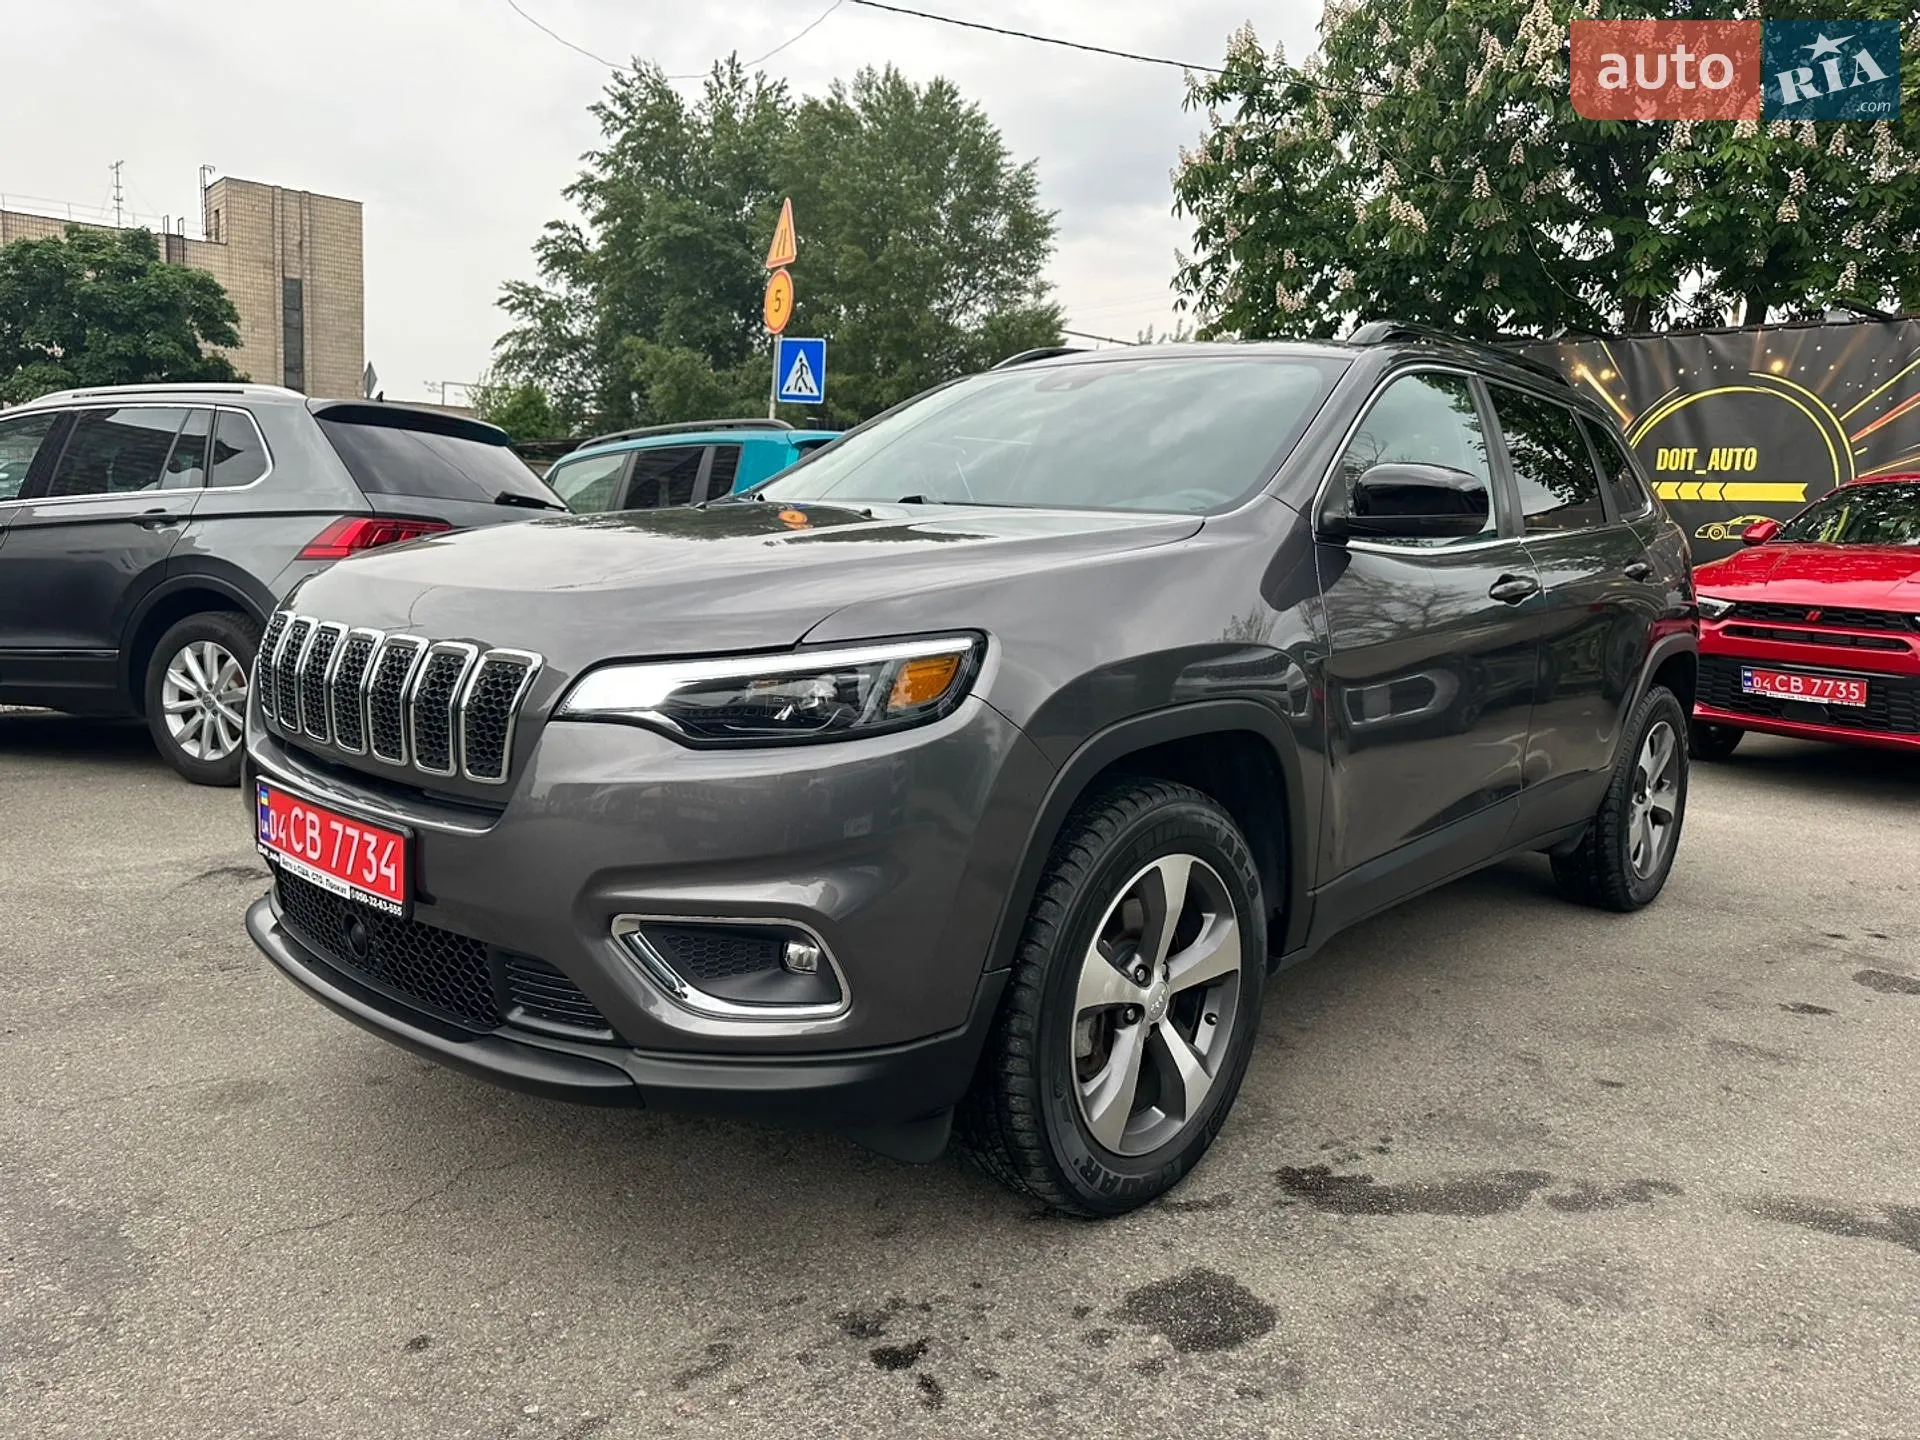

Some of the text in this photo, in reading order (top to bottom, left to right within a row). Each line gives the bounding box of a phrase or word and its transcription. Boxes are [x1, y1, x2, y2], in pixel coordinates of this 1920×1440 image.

[774, 289, 782, 312] 5
[1656, 447, 1758, 475] DOIT_AUTO
[1753, 677, 1771, 690] 04
[1775, 675, 1803, 693] CB
[1810, 679, 1860, 700] 7735
[269, 806, 396, 892] 04 CB 7734
